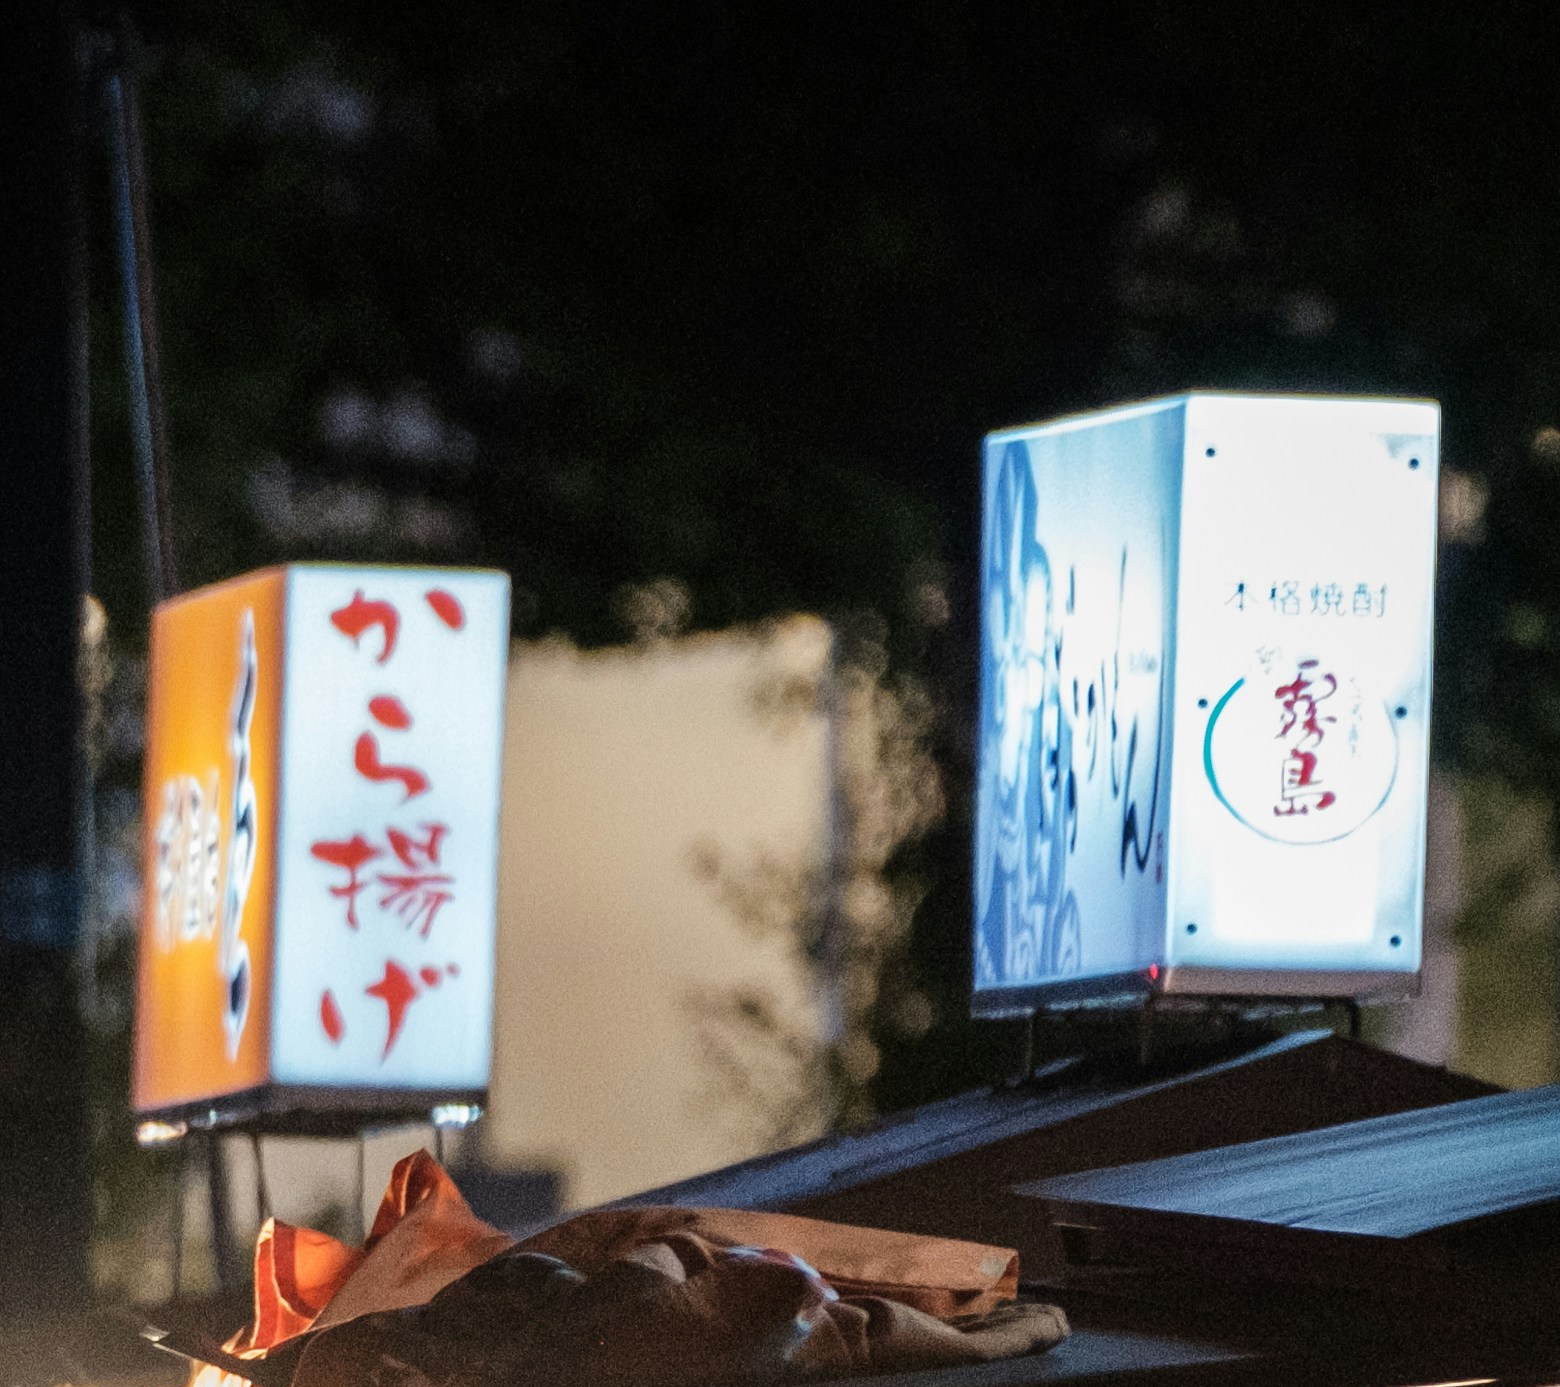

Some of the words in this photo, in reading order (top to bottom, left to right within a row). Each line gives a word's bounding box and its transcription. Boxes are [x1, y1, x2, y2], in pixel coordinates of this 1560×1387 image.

[1224, 579, 1389, 618] 本格焼酎
[1273, 658, 1338, 817] 霧島
[310, 588, 466, 1064] から揚げ
